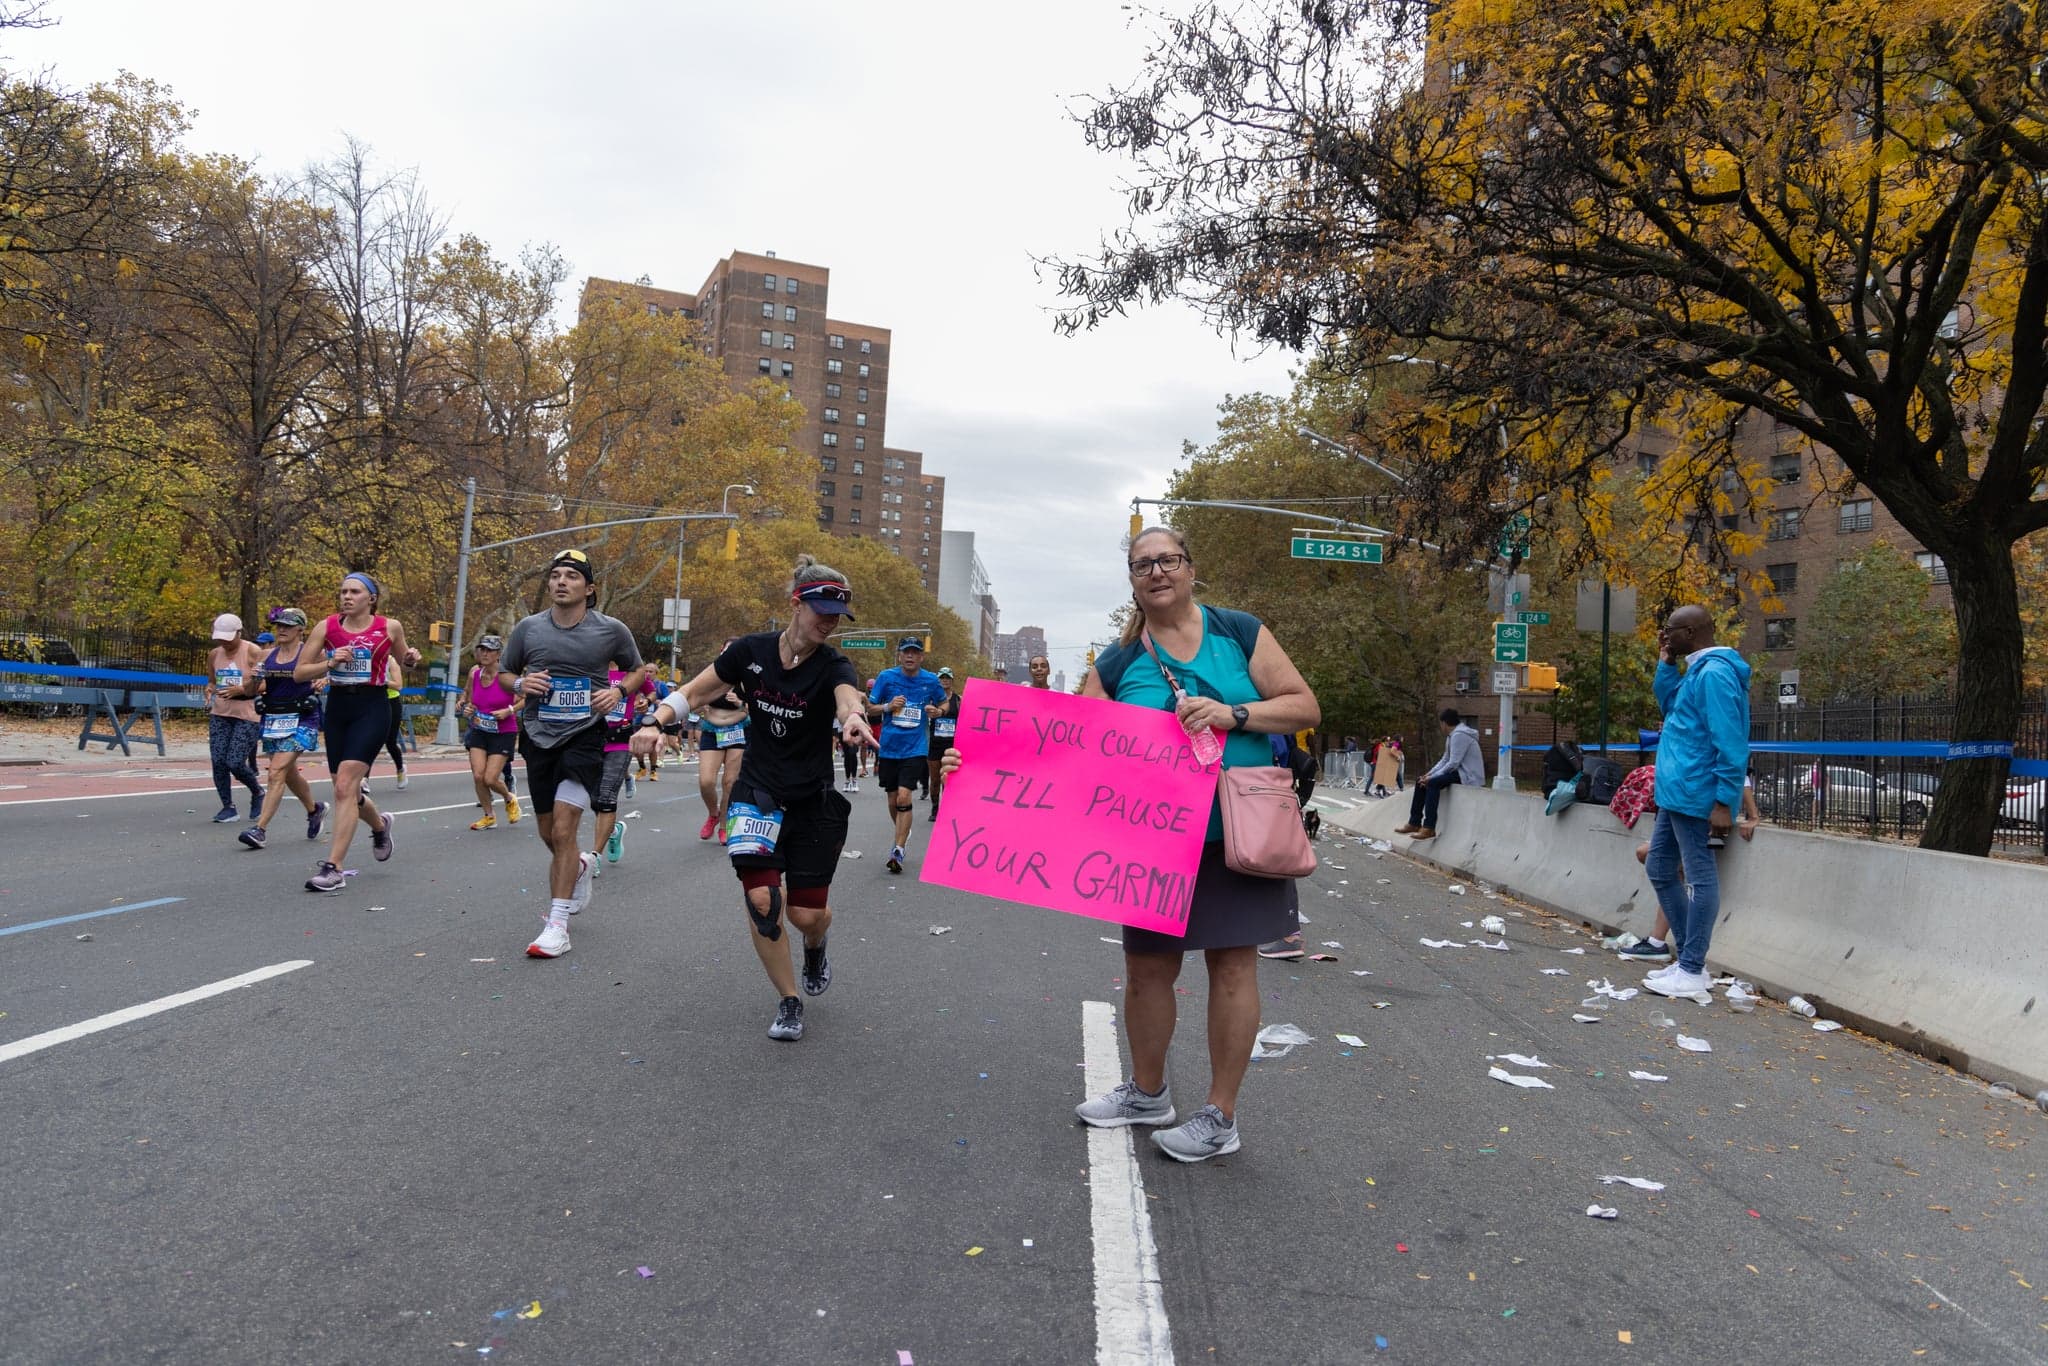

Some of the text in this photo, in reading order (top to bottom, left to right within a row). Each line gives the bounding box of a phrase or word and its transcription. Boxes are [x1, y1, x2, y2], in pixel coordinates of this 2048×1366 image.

[1305, 543, 1369, 558] E 124 St
[1526, 613, 1538, 623] 124
[560, 691, 585, 705] 60136
[756, 699, 803, 719] TEAM TCS
[971, 706, 1017, 734] IF
[1032, 716, 1087, 755] YOU
[980, 769, 1194, 834] I'LL PAUSE
[743, 818, 774, 837] 51017
[949, 818, 1196, 923] YOUR GARMIN
